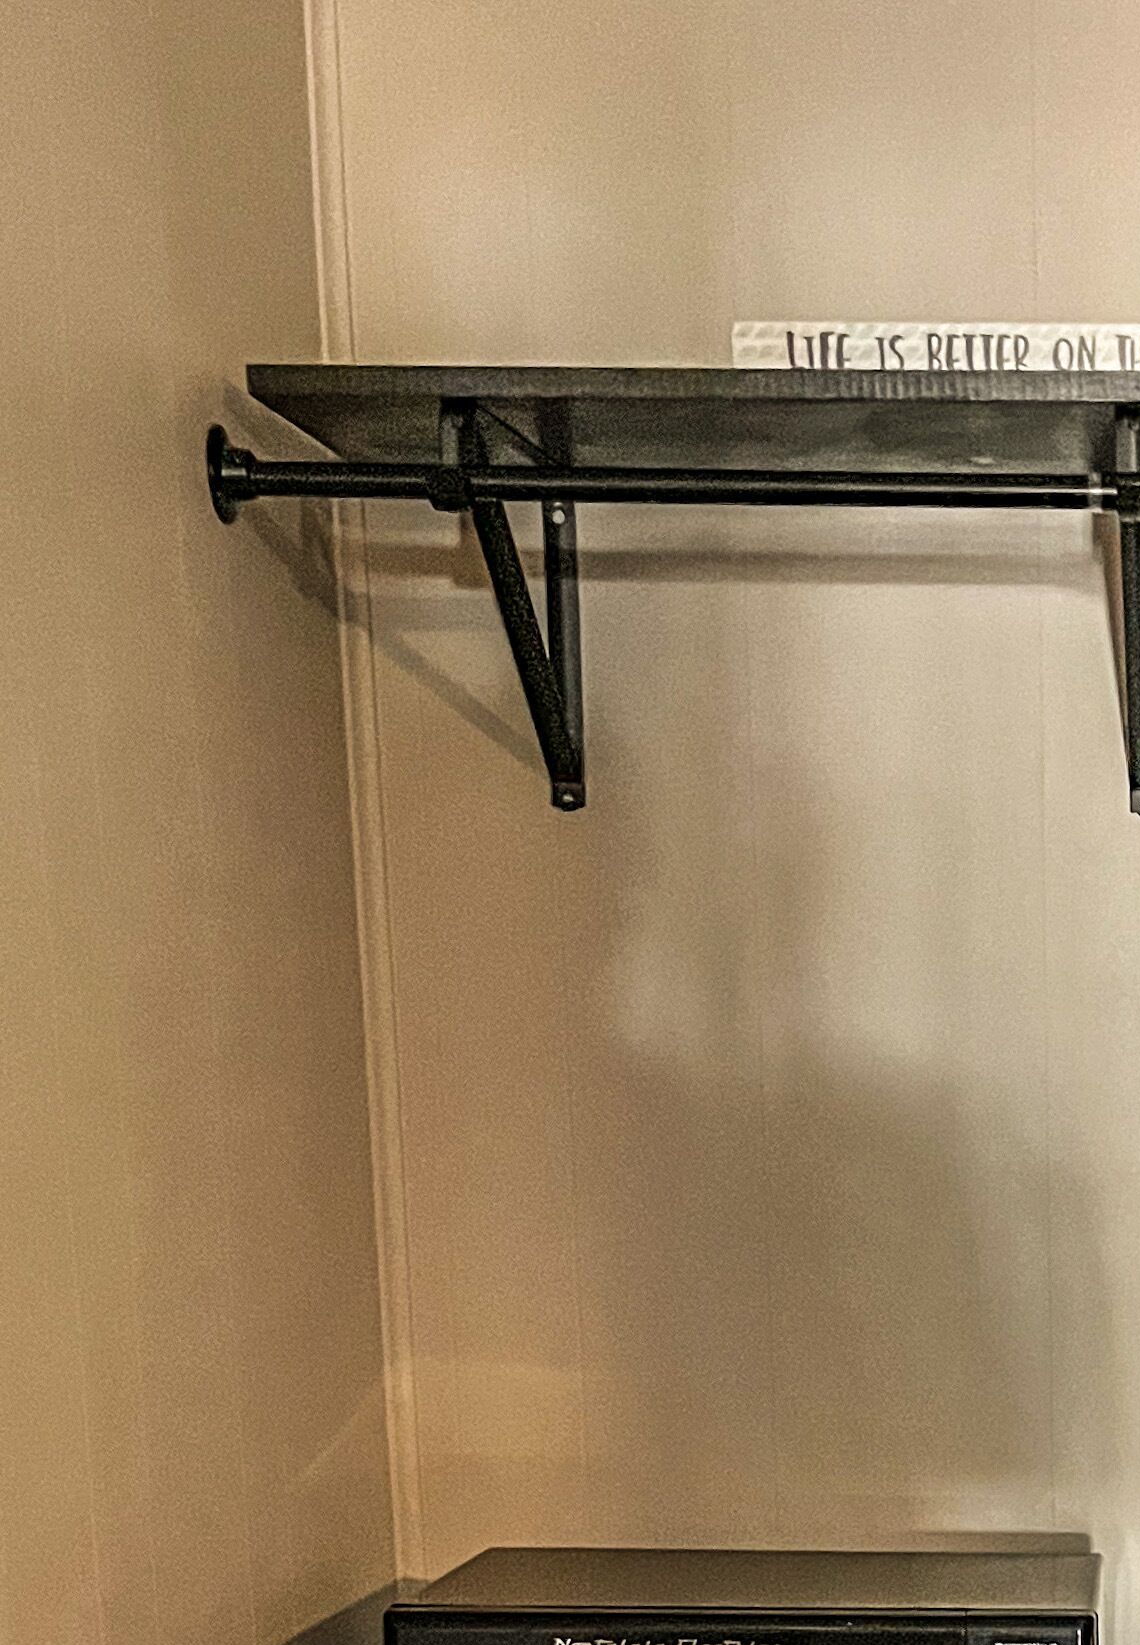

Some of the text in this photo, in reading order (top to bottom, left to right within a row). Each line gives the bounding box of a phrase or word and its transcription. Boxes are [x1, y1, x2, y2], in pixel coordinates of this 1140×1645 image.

[786, 331, 850, 369] LIFE
[874, 335, 905, 370] IS
[927, 333, 1030, 371] BETTER
[1052, 335, 1096, 370] ON
